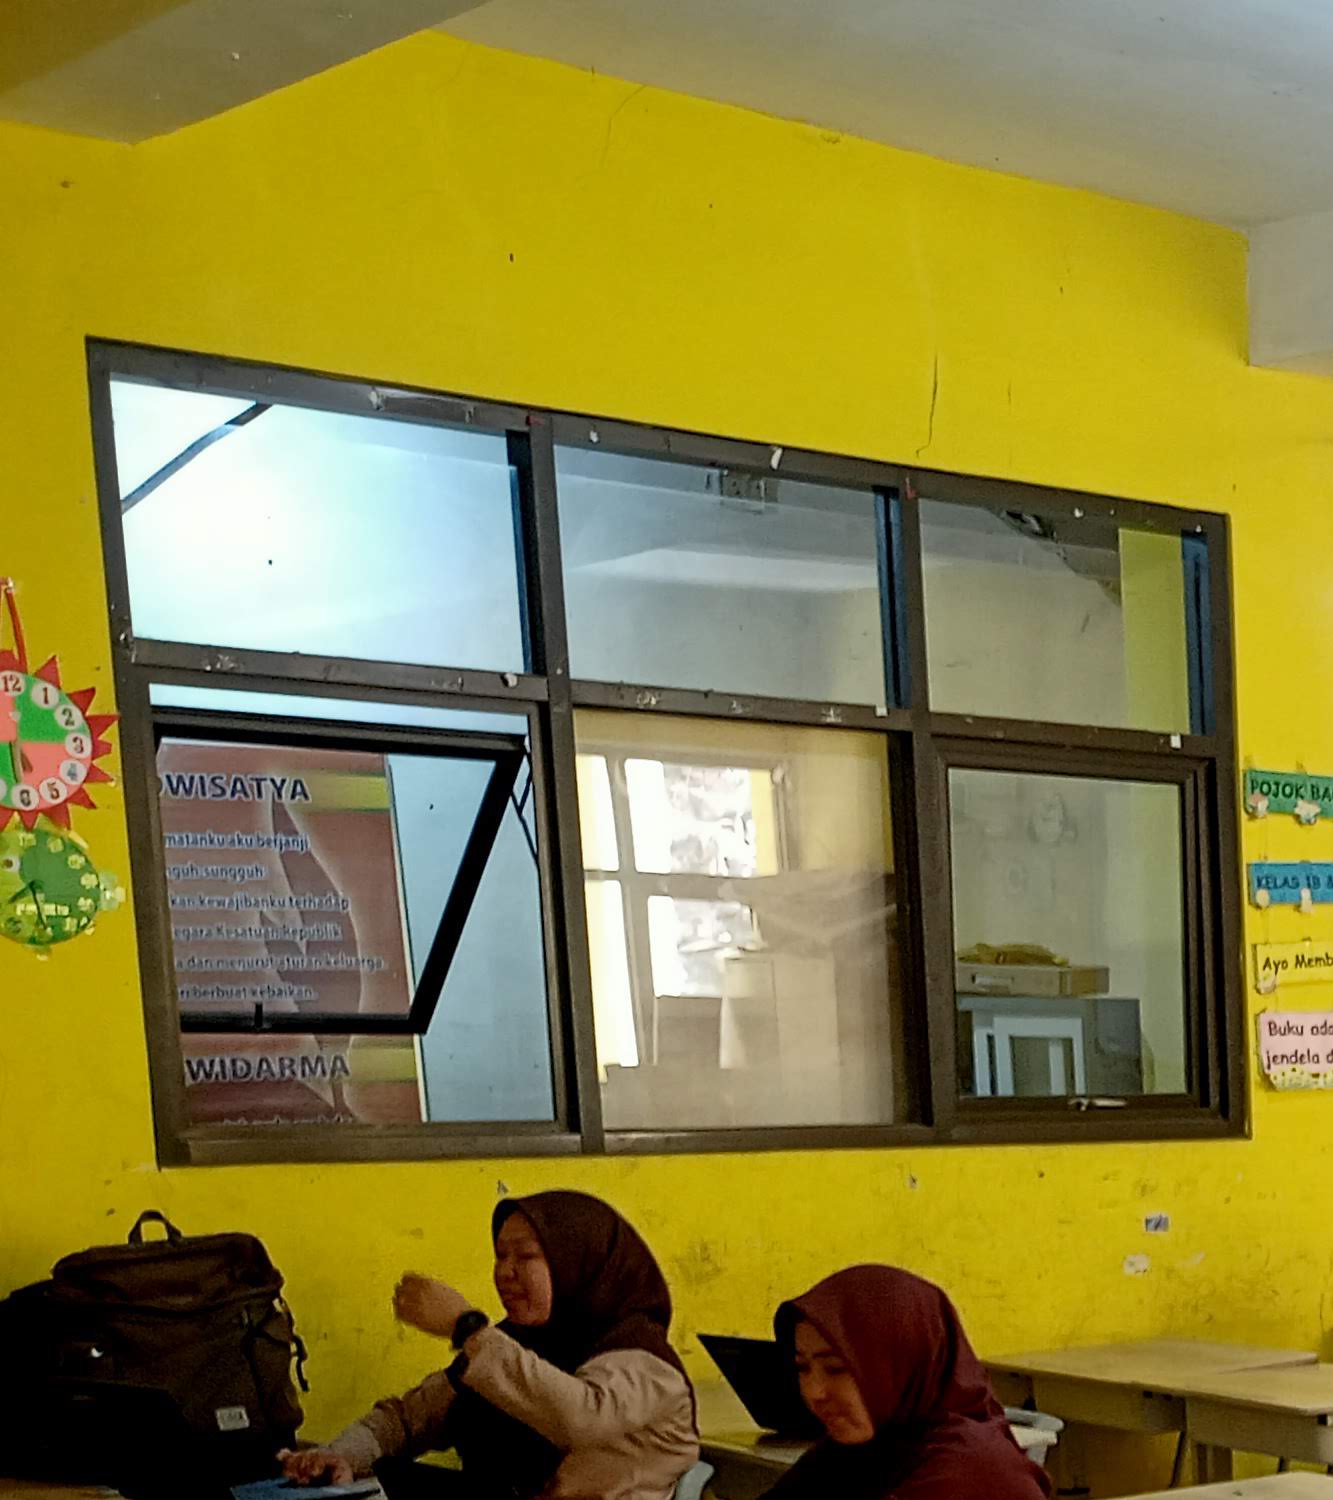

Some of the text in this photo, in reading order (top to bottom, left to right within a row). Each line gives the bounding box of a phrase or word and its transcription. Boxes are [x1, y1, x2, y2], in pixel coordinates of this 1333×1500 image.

[2, 674, 22, 693] 12
[42, 687, 49, 706] 1
[62, 708, 75, 726] 2
[72, 736, 84, 754] 3
[67, 763, 78, 781] 4
[47, 782, 60, 800] 5
[159, 773, 310, 801] WISATYA
[1251, 779, 1306, 798] POJOK
[229, 836, 253, 849] aku
[257, 835, 310, 852] berjanji
[204, 864, 264, 882] sungguh
[1262, 956, 1288, 975] Ayo
[1268, 1020, 1304, 1036] Buku
[1265, 1048, 1320, 1070] jendela
